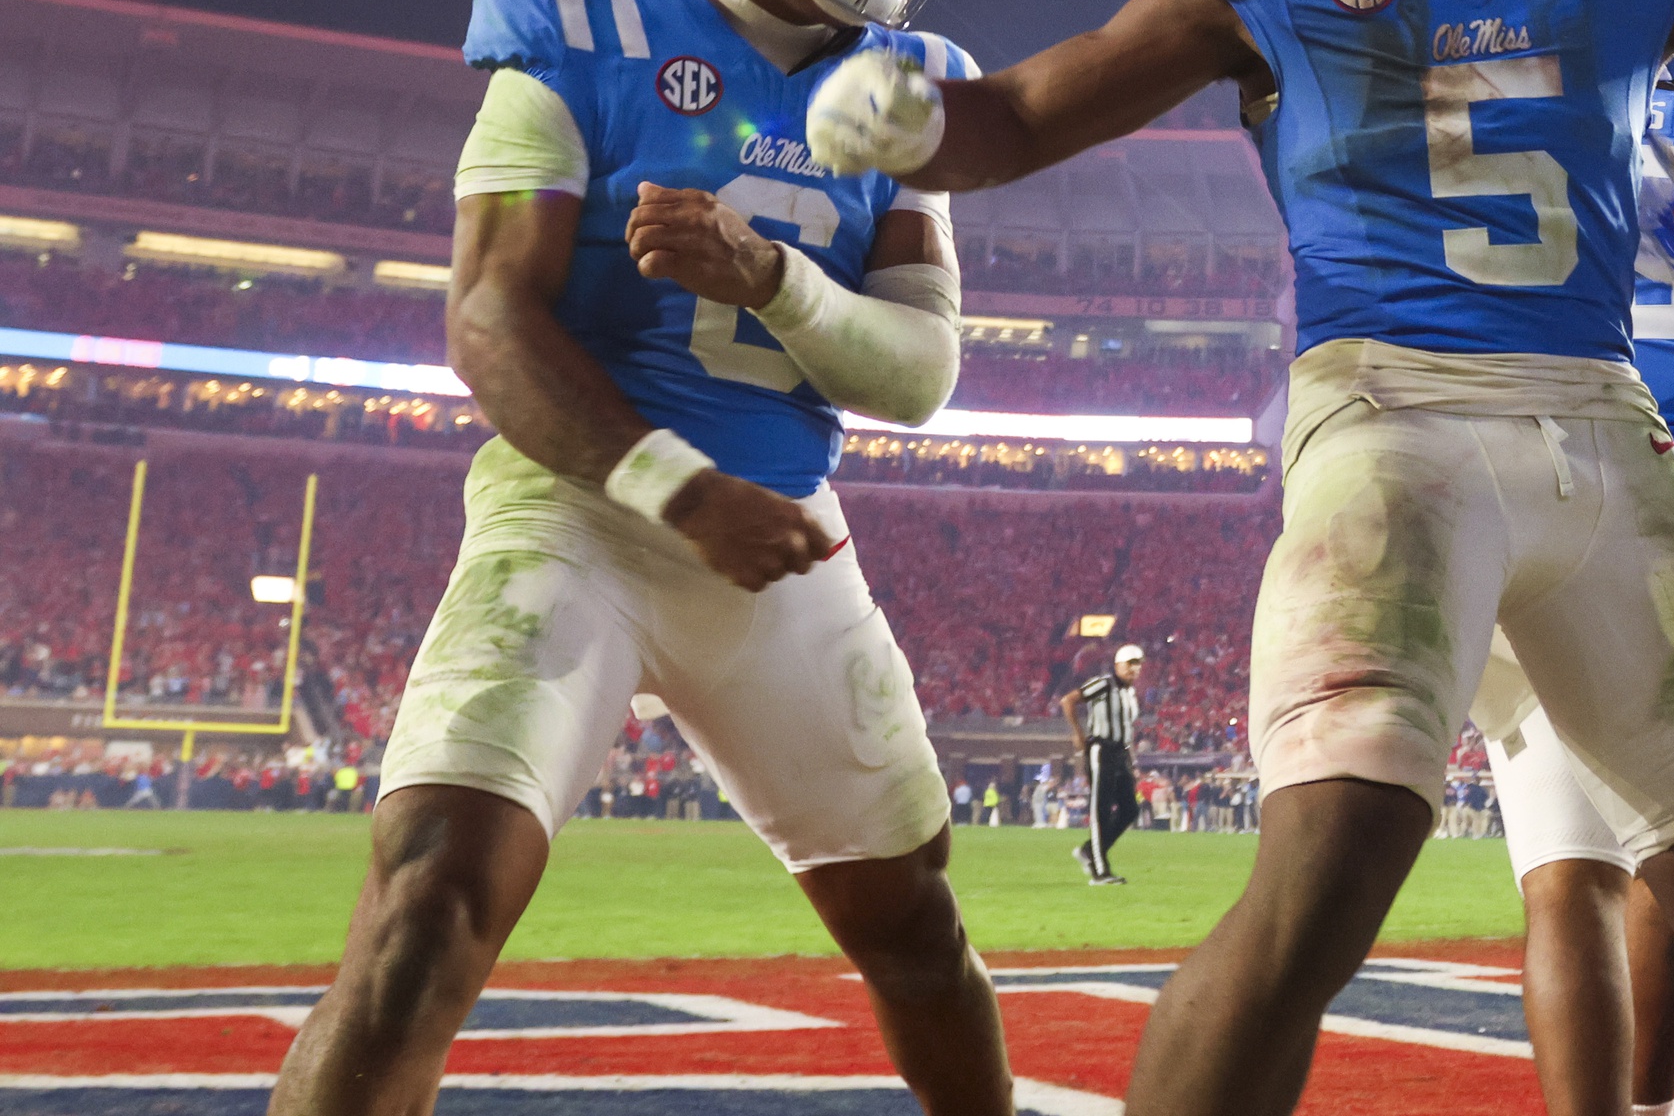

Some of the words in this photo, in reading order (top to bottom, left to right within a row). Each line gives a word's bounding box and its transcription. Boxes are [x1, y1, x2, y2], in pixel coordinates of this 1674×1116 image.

[1432, 22, 1471, 61] Ole
[1469, 17, 1532, 54] Miss
[662, 59, 717, 111] SEC
[739, 132, 776, 168] Ole
[1422, 55, 1579, 286] 5
